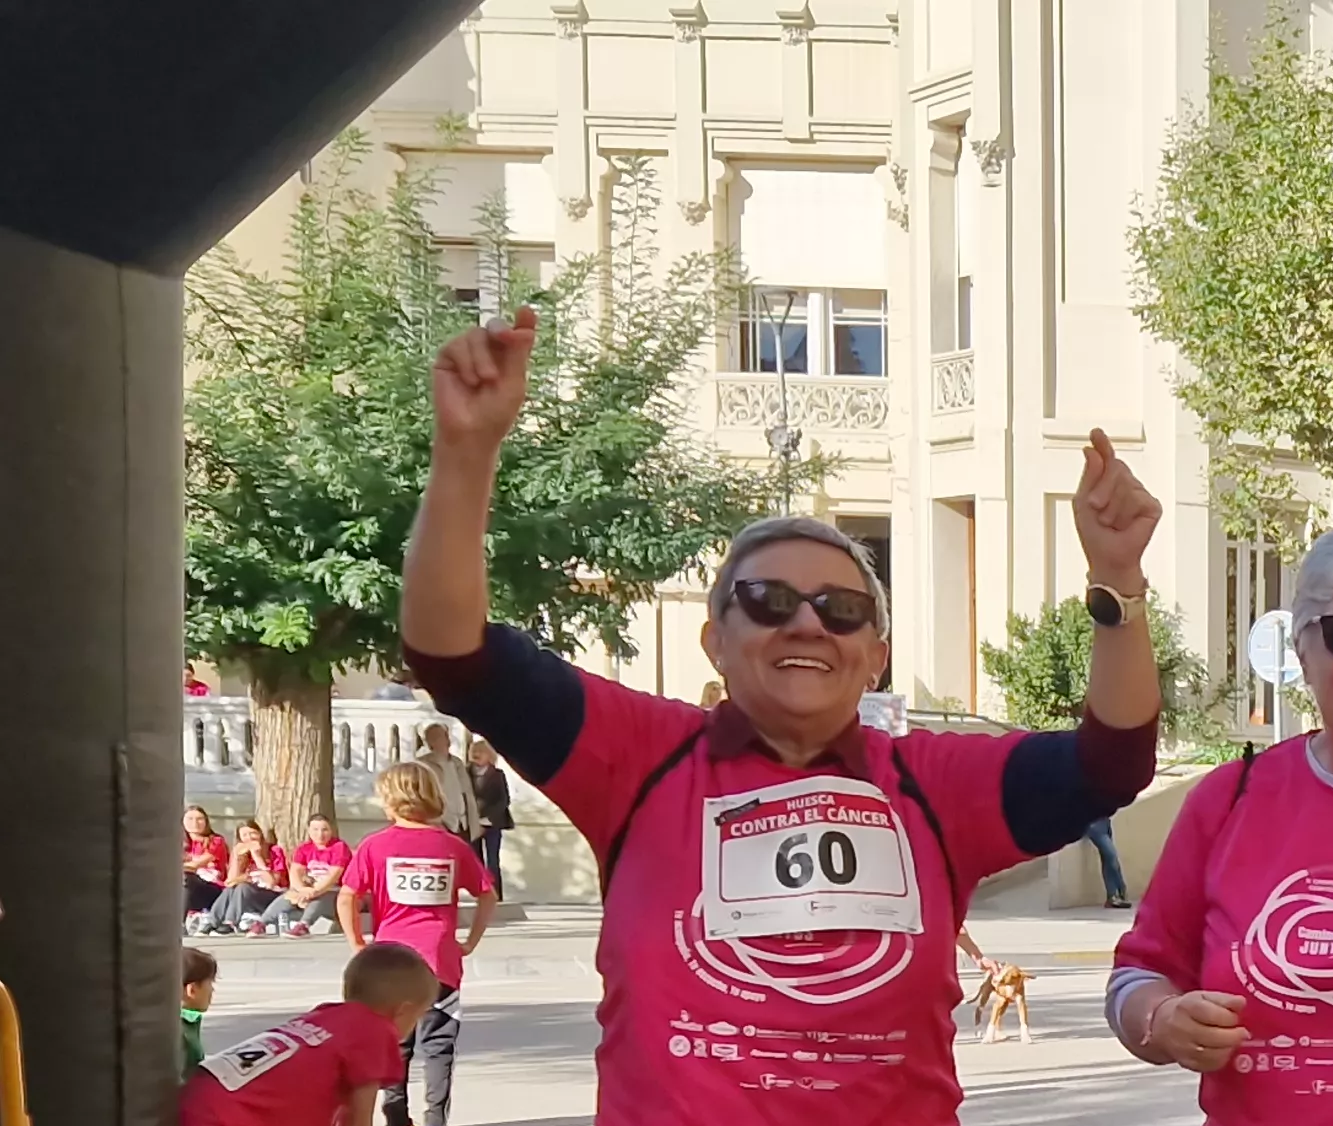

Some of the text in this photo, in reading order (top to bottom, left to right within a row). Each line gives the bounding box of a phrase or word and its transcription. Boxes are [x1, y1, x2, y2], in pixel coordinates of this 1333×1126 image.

[787, 794, 836, 811] HUESCA
[730, 805, 891, 836] CONTRA EL CÁNCER
[775, 831, 858, 889] 60
[396, 874, 447, 892] 2625
